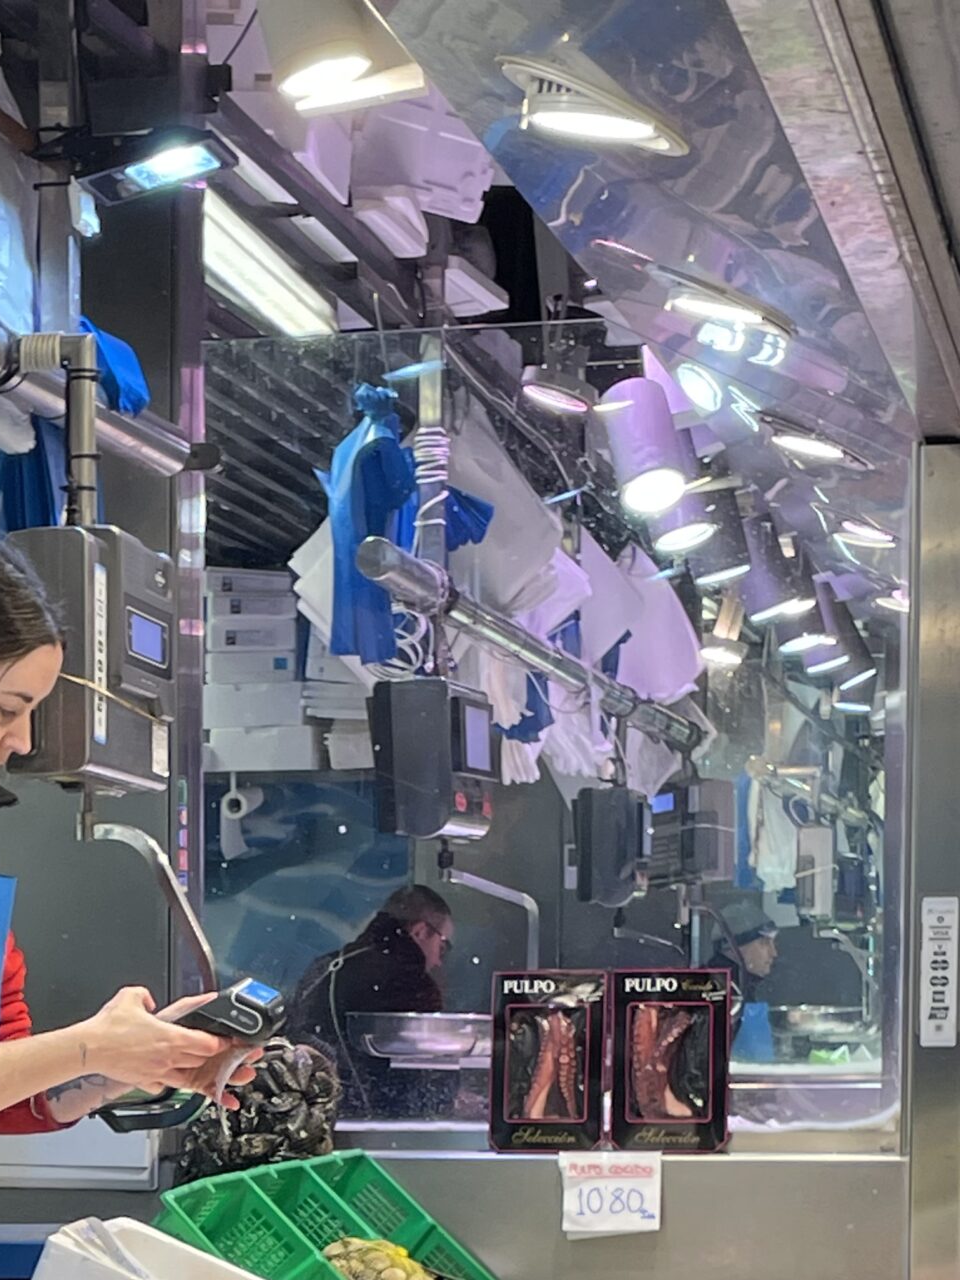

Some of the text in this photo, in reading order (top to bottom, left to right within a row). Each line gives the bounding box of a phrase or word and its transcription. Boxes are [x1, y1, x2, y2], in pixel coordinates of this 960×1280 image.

[503, 979, 556, 994] PULPO
[624, 977, 678, 993] PULPO
[511, 1127, 577, 1145] Selección
[634, 1127, 700, 1145] Selección
